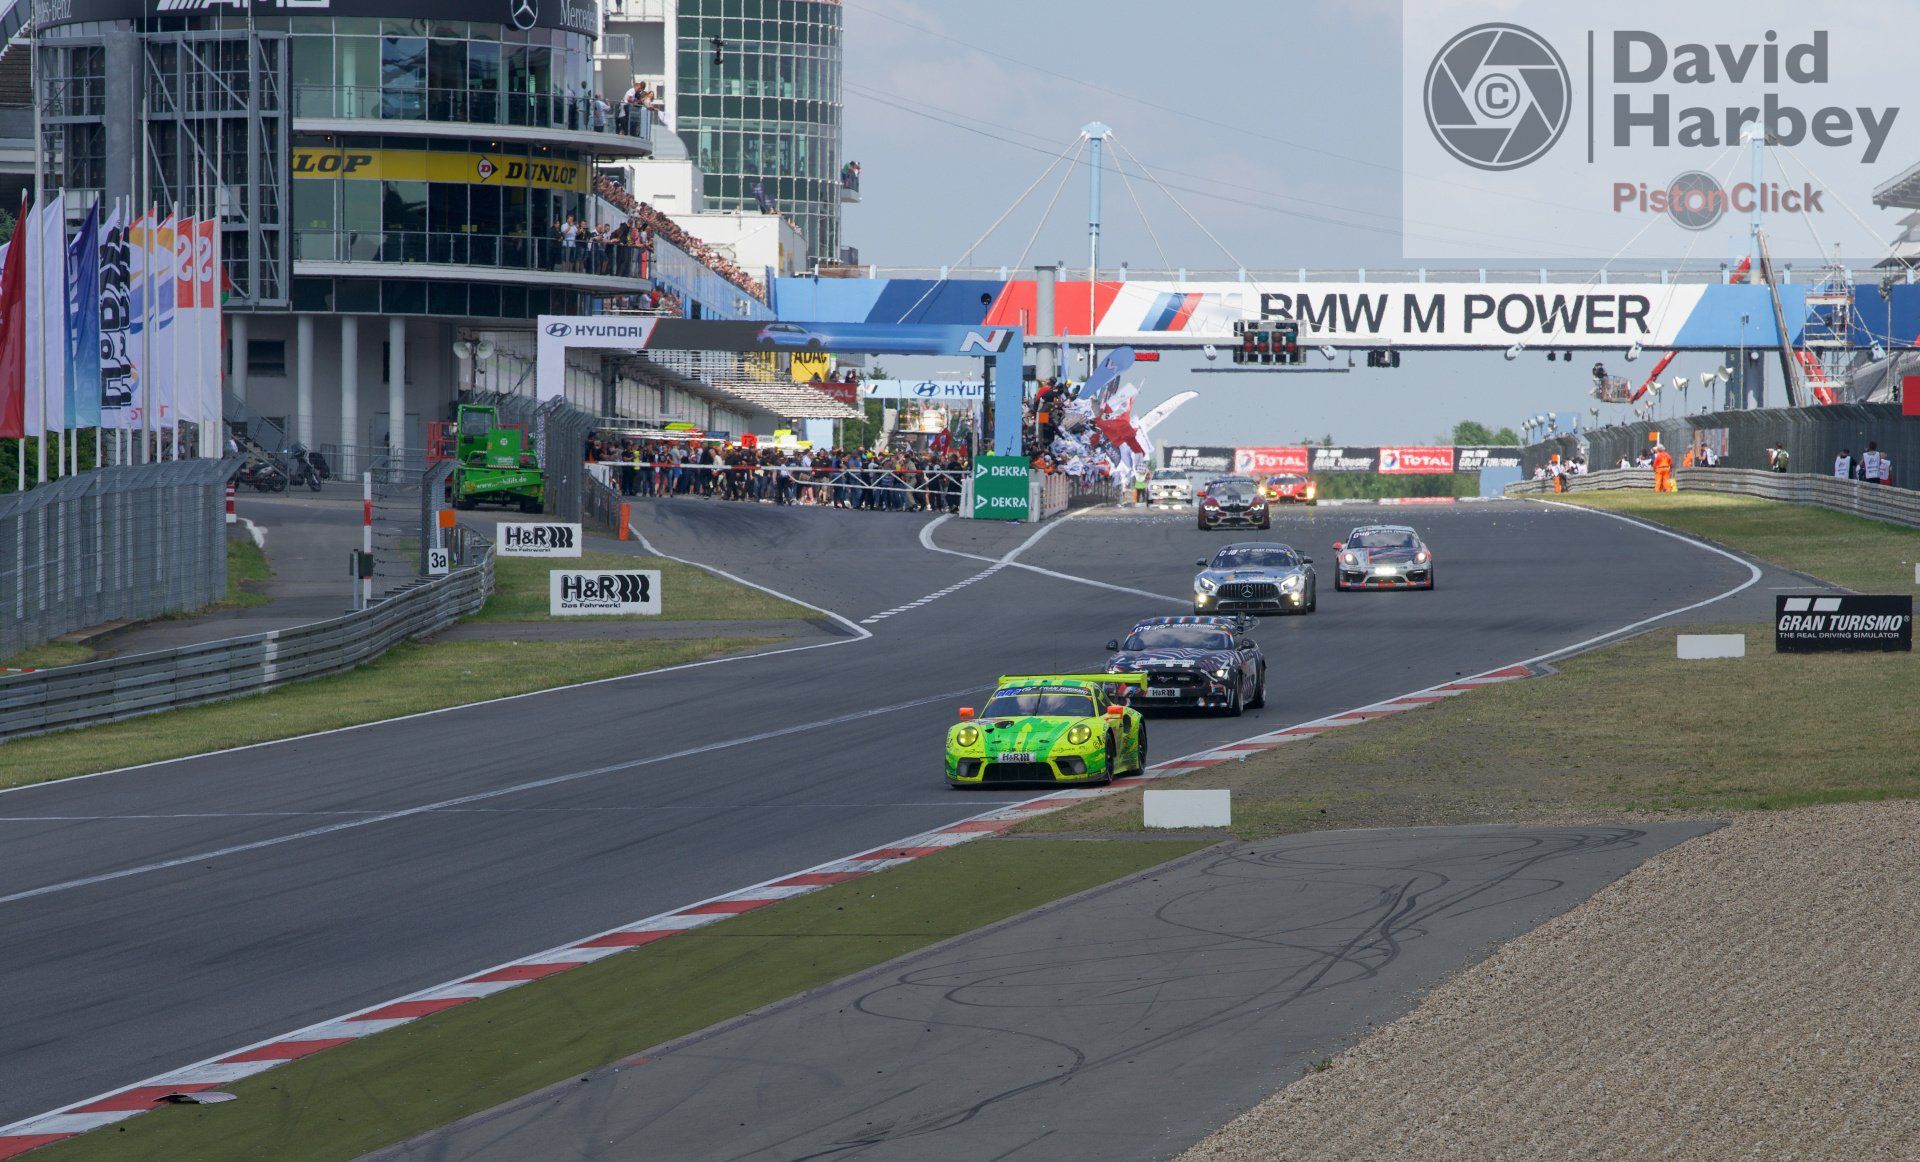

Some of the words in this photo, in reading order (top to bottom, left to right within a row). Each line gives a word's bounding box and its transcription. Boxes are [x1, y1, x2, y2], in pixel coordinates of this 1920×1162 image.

[291, 154, 373, 172] LOP
[505, 162, 577, 184] DUNLOP
[1260, 293, 1388, 333] BMW
[1403, 294, 1445, 333] M
[1464, 293, 1651, 334] POWER
[575, 326, 642, 337] HYUNDAI
[1255, 454, 1305, 466] TOTAL
[1401, 454, 1450, 466] TOTAL
[991, 466, 1028, 477] DEKRA
[991, 497, 1028, 508] DEKRA
[505, 525, 551, 547] H&R
[431, 552, 447, 568] 3a
[561, 575, 620, 602] H&R
[1778, 615, 1826, 631] GRAN
